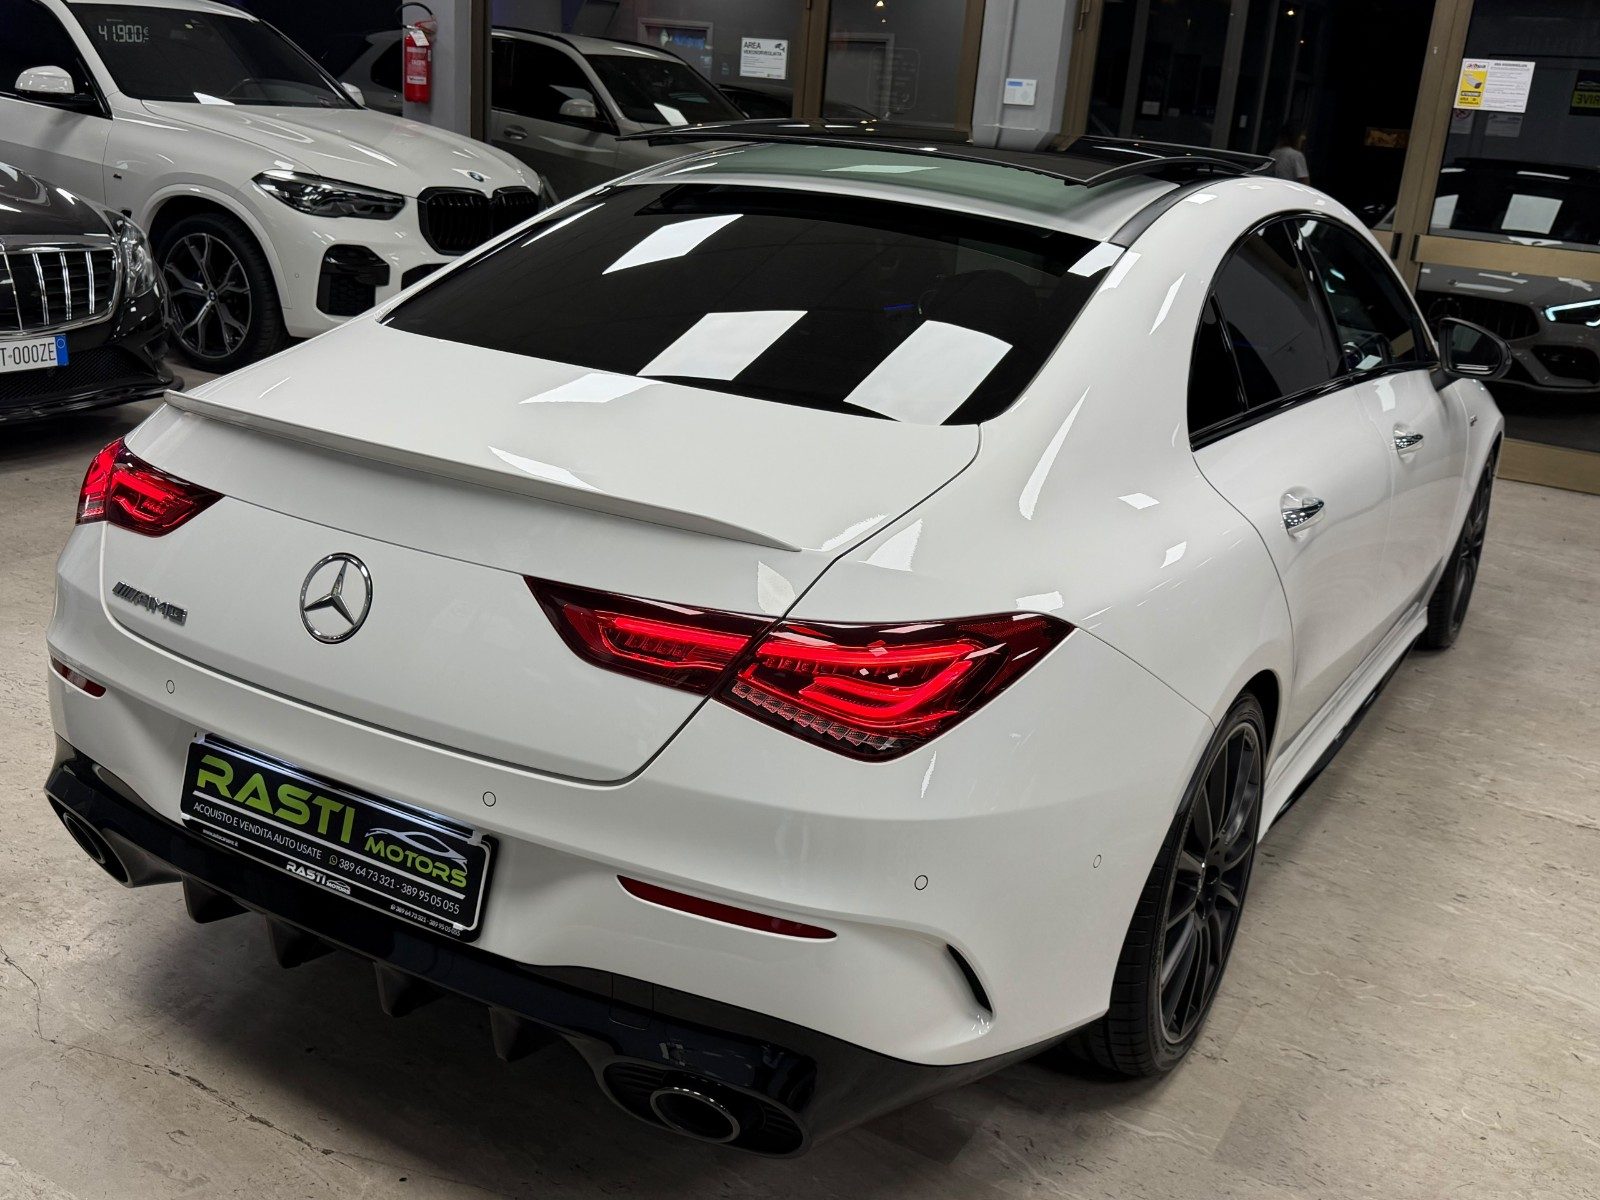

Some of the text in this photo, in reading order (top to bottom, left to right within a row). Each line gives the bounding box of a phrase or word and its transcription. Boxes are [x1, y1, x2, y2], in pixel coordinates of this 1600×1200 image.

[744, 41, 761, 49] AREA
[196, 754, 356, 844] RASTI
[192, 802, 323, 860] ACQUISTO E VENDITA AUTO USATE
[286, 861, 327, 885] RASTI
[325, 880, 351, 895] MOTORS
[338, 858, 355, 872] 389
[355, 865, 367, 876] 64
[367, 869, 379, 882] 73
[379, 873, 395, 889] 321
[400, 883, 418, 898] 389
[418, 890, 430, 903] 95
[430, 894, 442, 908] 05
[442, 898, 460, 915] 055
[364, 836, 468, 889] MOTORS
